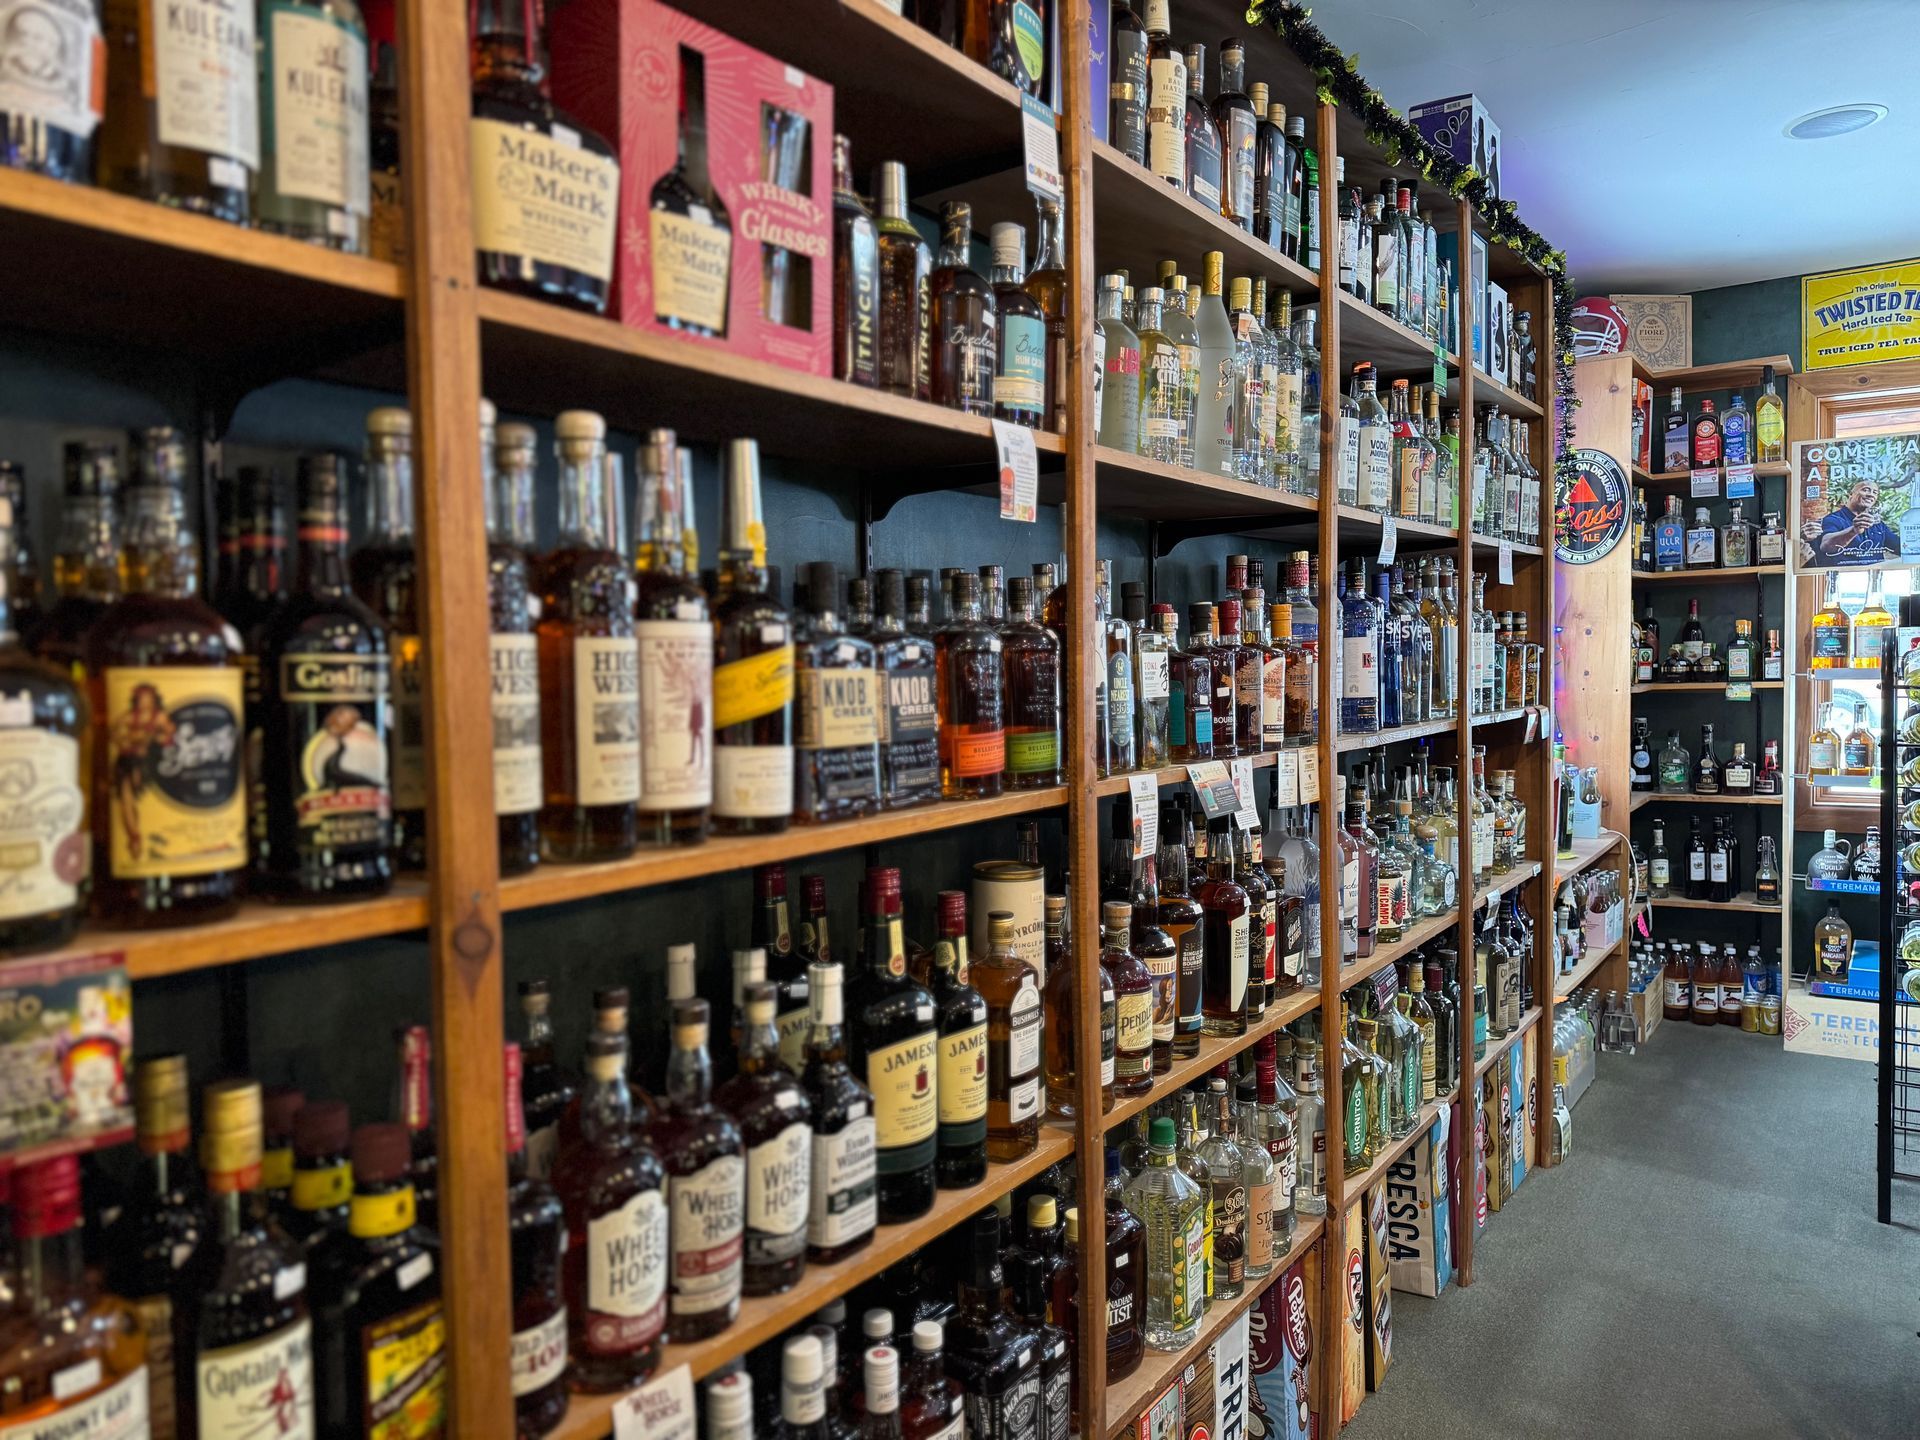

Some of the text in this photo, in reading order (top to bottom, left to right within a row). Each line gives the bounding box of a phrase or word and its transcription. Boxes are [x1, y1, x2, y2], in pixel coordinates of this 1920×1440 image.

[532, 172, 608, 219] Mark
[740, 181, 825, 224] WHISKY
[740, 207, 829, 258] Glasses
[681, 251, 725, 278] Mark
[1869, 281, 1897, 291] Original
[857, 254, 873, 359] TINCUP
[1814, 291, 1902, 328] TWISTED
[917, 275, 931, 373] TINCUP
[1841, 316, 1869, 331] Hard
[1871, 313, 1893, 325] Iced
[1894, 312, 1913, 322] Tea
[1817, 346, 1846, 356] TRUE
[1848, 343, 1875, 352] ICED
[1878, 340, 1899, 348] TEA
[1807, 439, 1920, 463] COME HA
[1575, 462, 1590, 471] ON
[1589, 463, 1616, 502] DRAUGHT
[1806, 460, 1907, 482] A DRINK
[1582, 533, 1600, 543] ALE
[1659, 537, 1680, 546] ULLR
[1143, 661, 1158, 671] TOKI
[823, 677, 867, 707] KNOB
[890, 676, 930, 706] KNOB
[832, 706, 875, 718] CREEK
[899, 703, 937, 717] CREEK
[1815, 864, 1844, 872] TEQUILA
[1379, 897, 1390, 925] CAMPO
[1151, 961, 1170, 976] STILL
[1012, 1007, 1040, 1027] BUSHMILLS
[1822, 1030, 1848, 1039] SMALL
[1353, 1089, 1362, 1151] HORNITOS
[1387, 1147, 1421, 1263] FRESCA
[1215, 1216, 1235, 1227] Double
[204, 1350, 284, 1398] Captain
[1003, 1394, 1020, 1423] JACK
[1045, 1386, 1058, 1406] JACK
[32, 1404, 102, 1440] MOUNT
